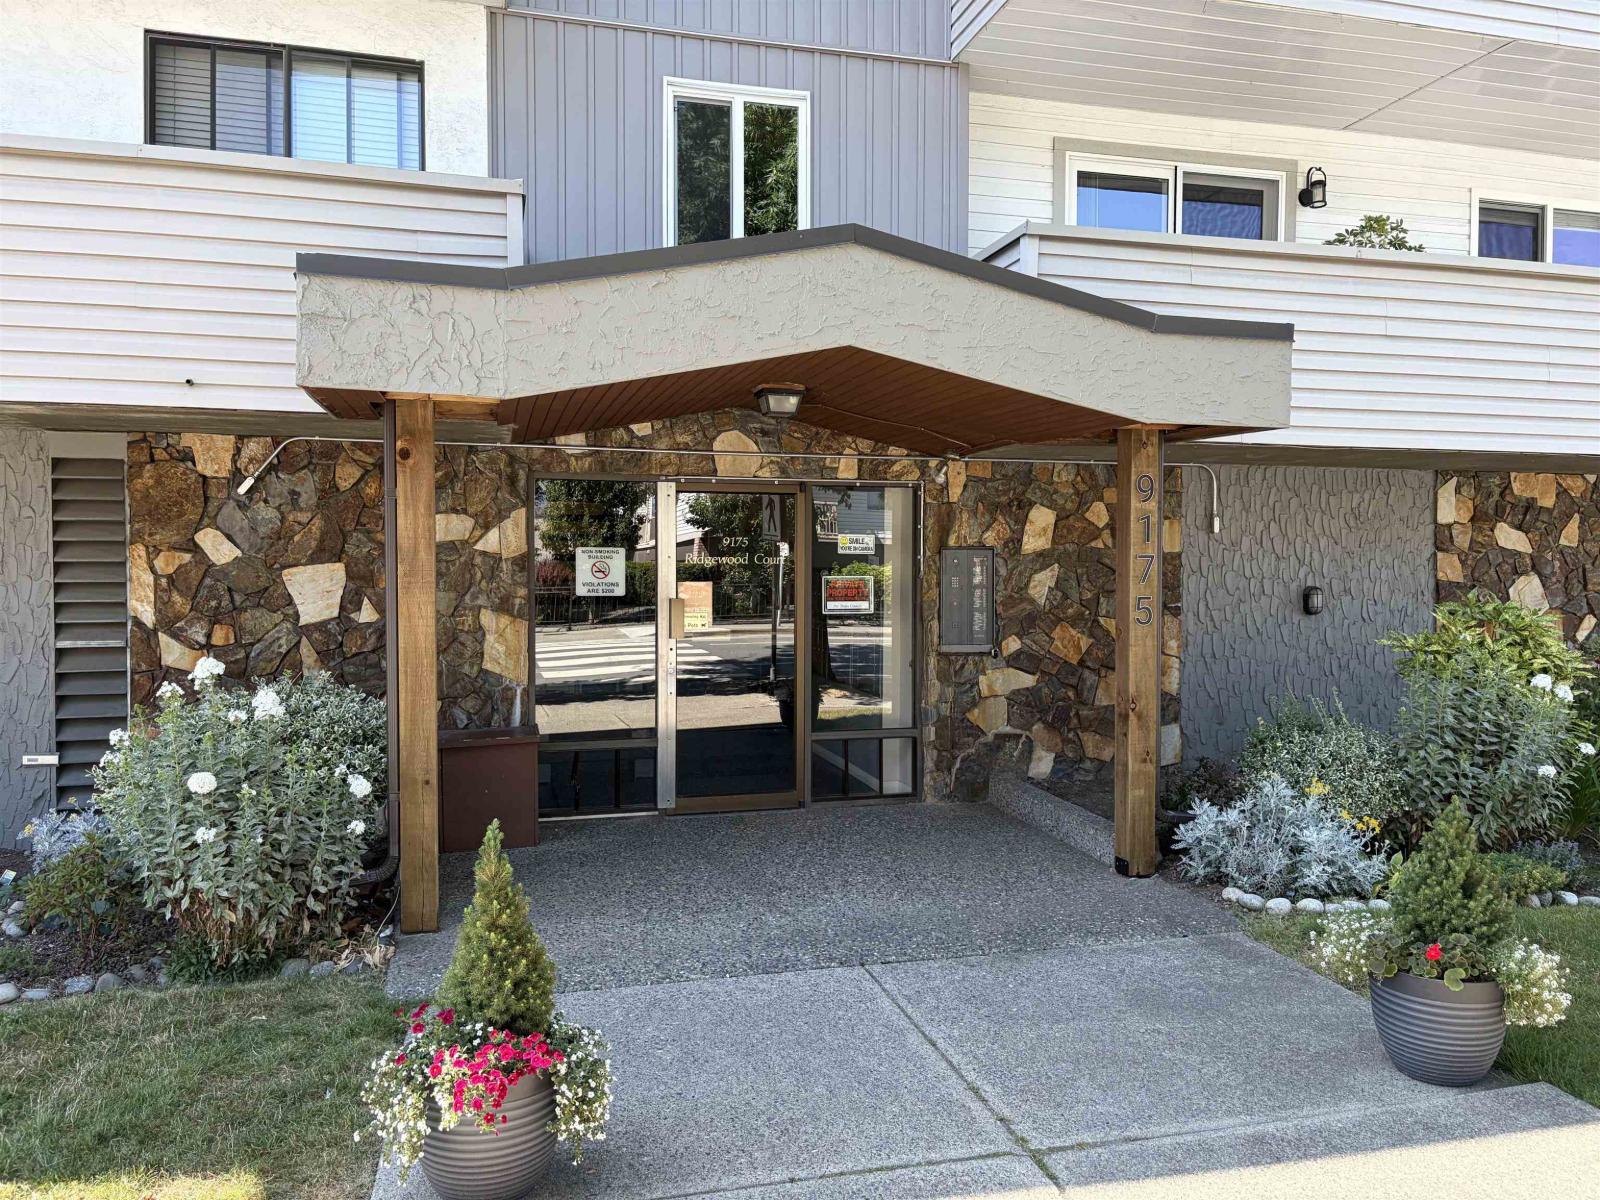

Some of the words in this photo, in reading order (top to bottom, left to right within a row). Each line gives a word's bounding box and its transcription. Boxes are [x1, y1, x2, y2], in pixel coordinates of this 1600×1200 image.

[722, 536, 749, 548] 9175
[848, 537, 866, 545] SMILE
[685, 552, 749, 568] Ridgewood
[827, 588, 869, 597] PROPERTY
